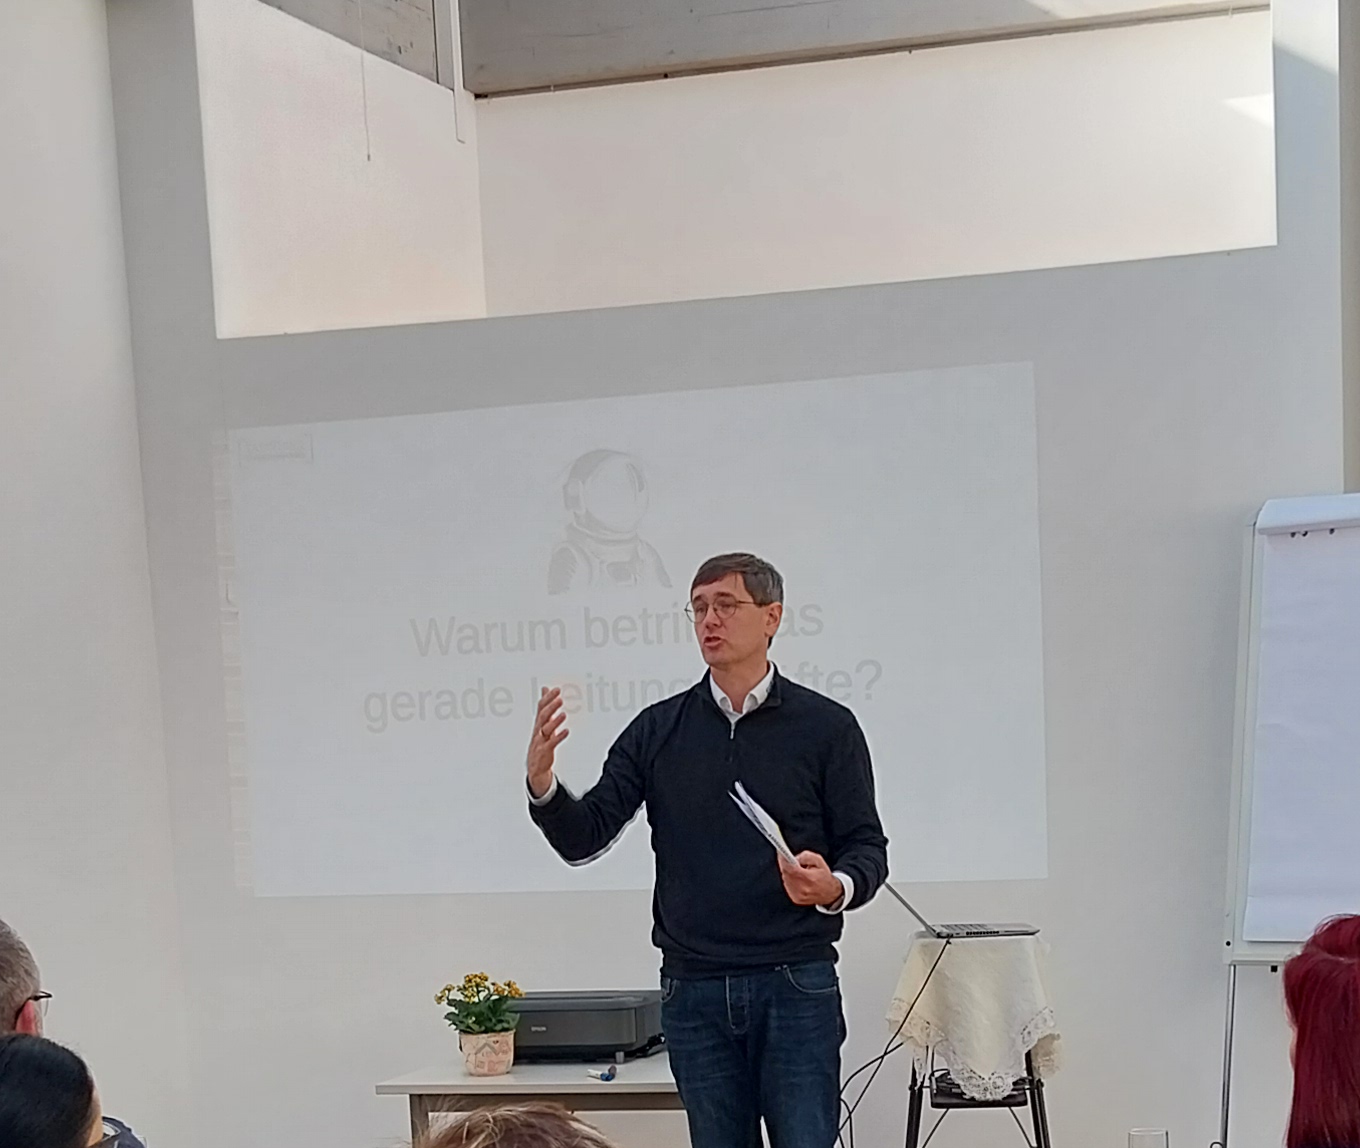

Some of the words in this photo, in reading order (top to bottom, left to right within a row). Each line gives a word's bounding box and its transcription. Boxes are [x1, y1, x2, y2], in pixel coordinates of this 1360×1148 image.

[408, 615, 567, 657] Warum
[583, 602, 695, 649] betri
[777, 603, 824, 637] as
[363, 677, 514, 734] gerade
